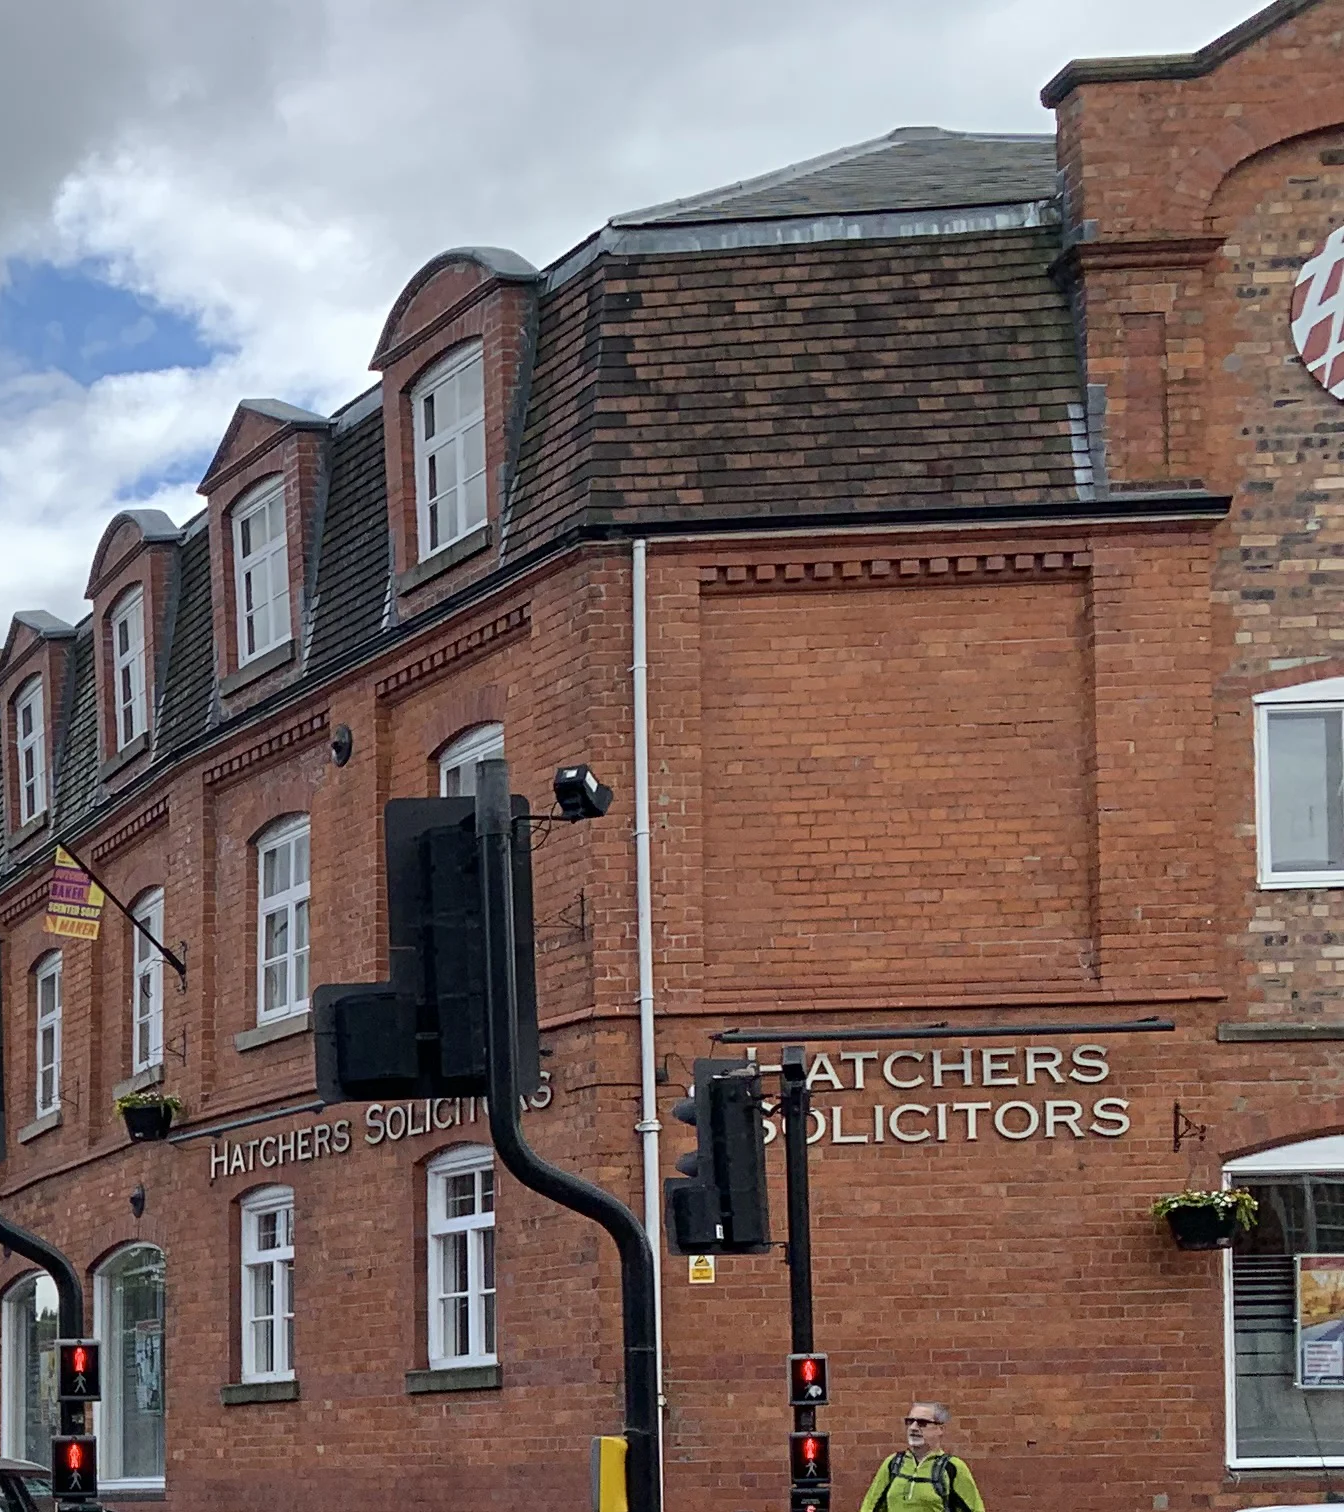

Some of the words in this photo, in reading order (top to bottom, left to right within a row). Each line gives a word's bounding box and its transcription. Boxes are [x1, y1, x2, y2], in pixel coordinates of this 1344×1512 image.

[58, 919, 97, 937] MAKER
[746, 1044, 1111, 1091] ATCHERS
[210, 1119, 352, 1179] HATCHERS
